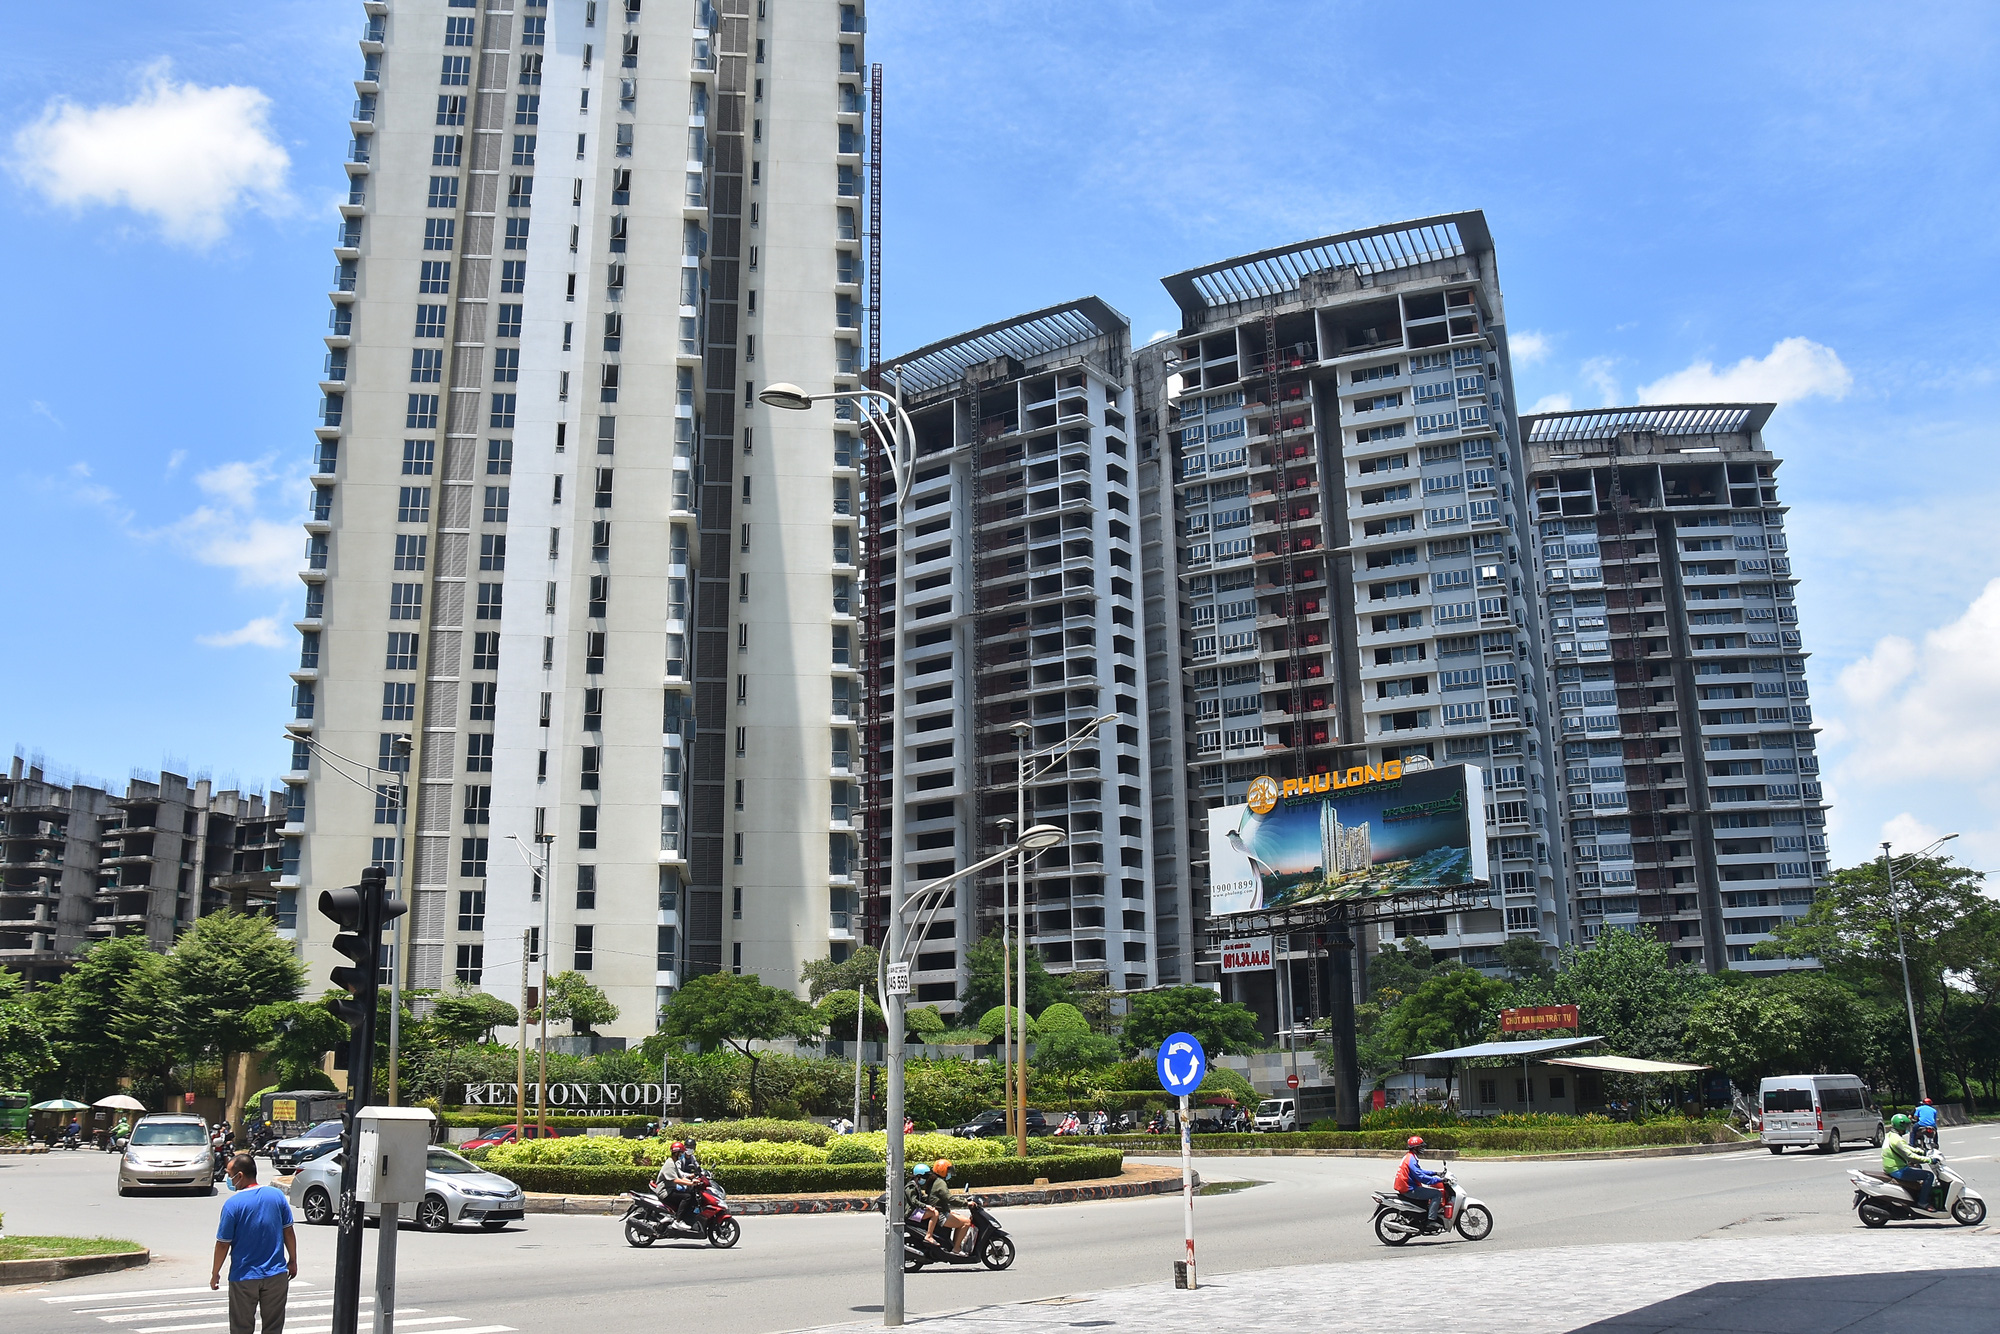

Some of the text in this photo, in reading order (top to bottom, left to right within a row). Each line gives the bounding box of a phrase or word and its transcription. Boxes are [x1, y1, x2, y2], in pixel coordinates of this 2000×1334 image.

[1382, 802, 1424, 816] DRAGON
[1212, 880, 1253, 893] 1900 1899
[1522, 1016, 1530, 1024] AN
[597, 1083, 683, 1105] NODE
